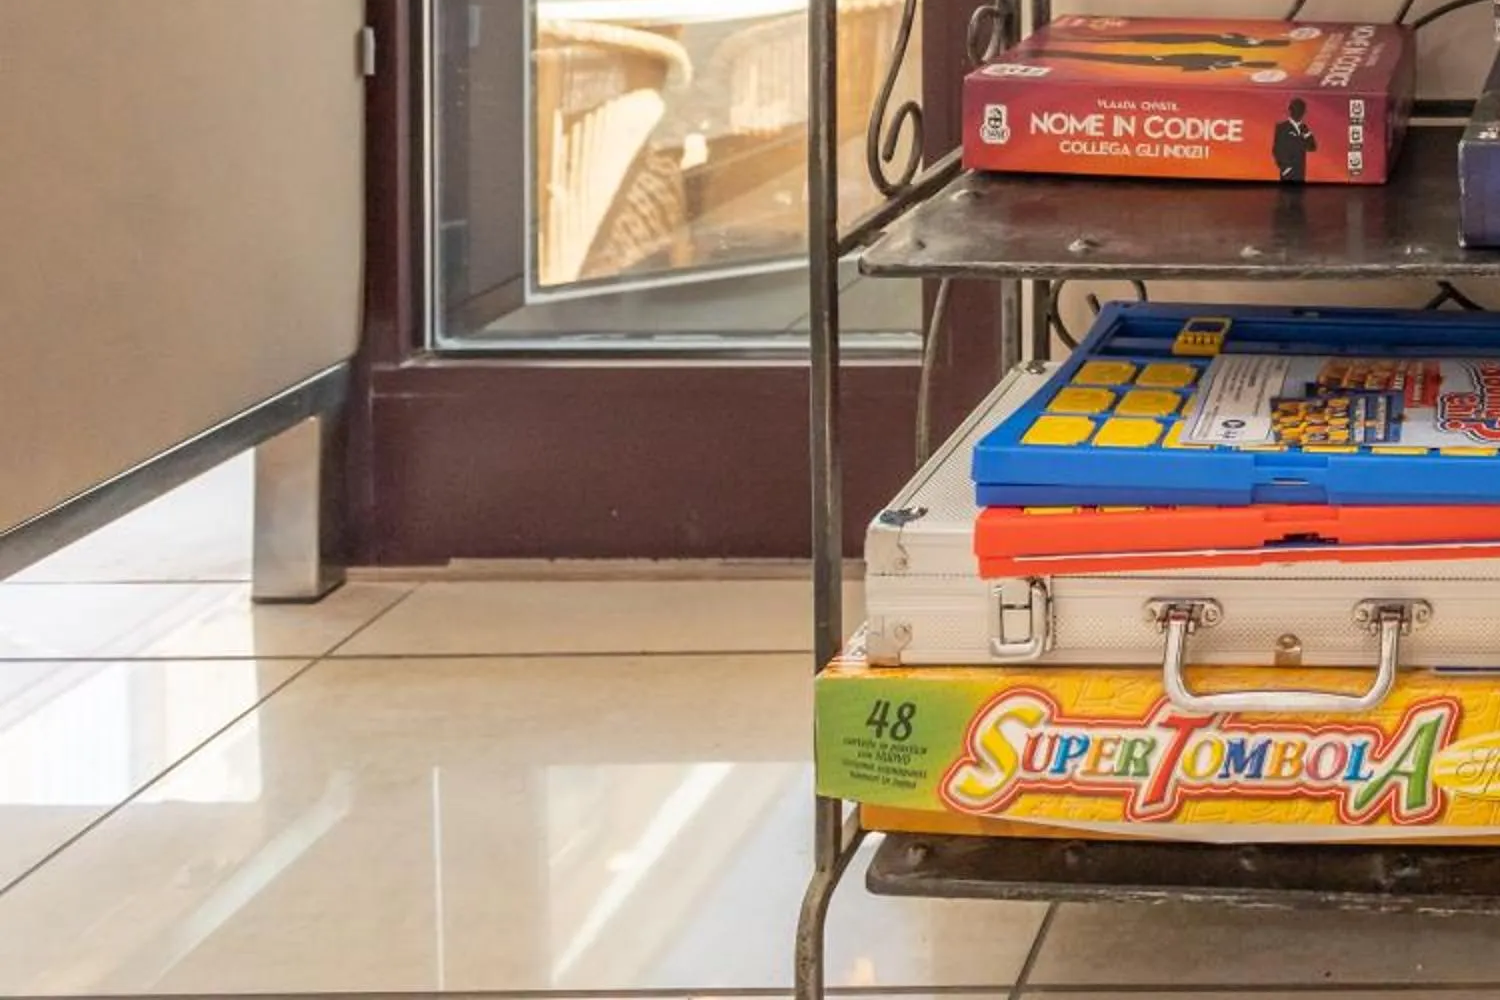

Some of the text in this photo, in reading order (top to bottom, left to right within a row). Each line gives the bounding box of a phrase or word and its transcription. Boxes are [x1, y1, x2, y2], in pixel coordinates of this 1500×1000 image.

[1030, 112, 1105, 137] NOME
[1113, 115, 1136, 138] IN
[1143, 115, 1244, 141] CODICE
[1059, 140, 1131, 156] COLLEGA
[866, 699, 917, 741] 48
